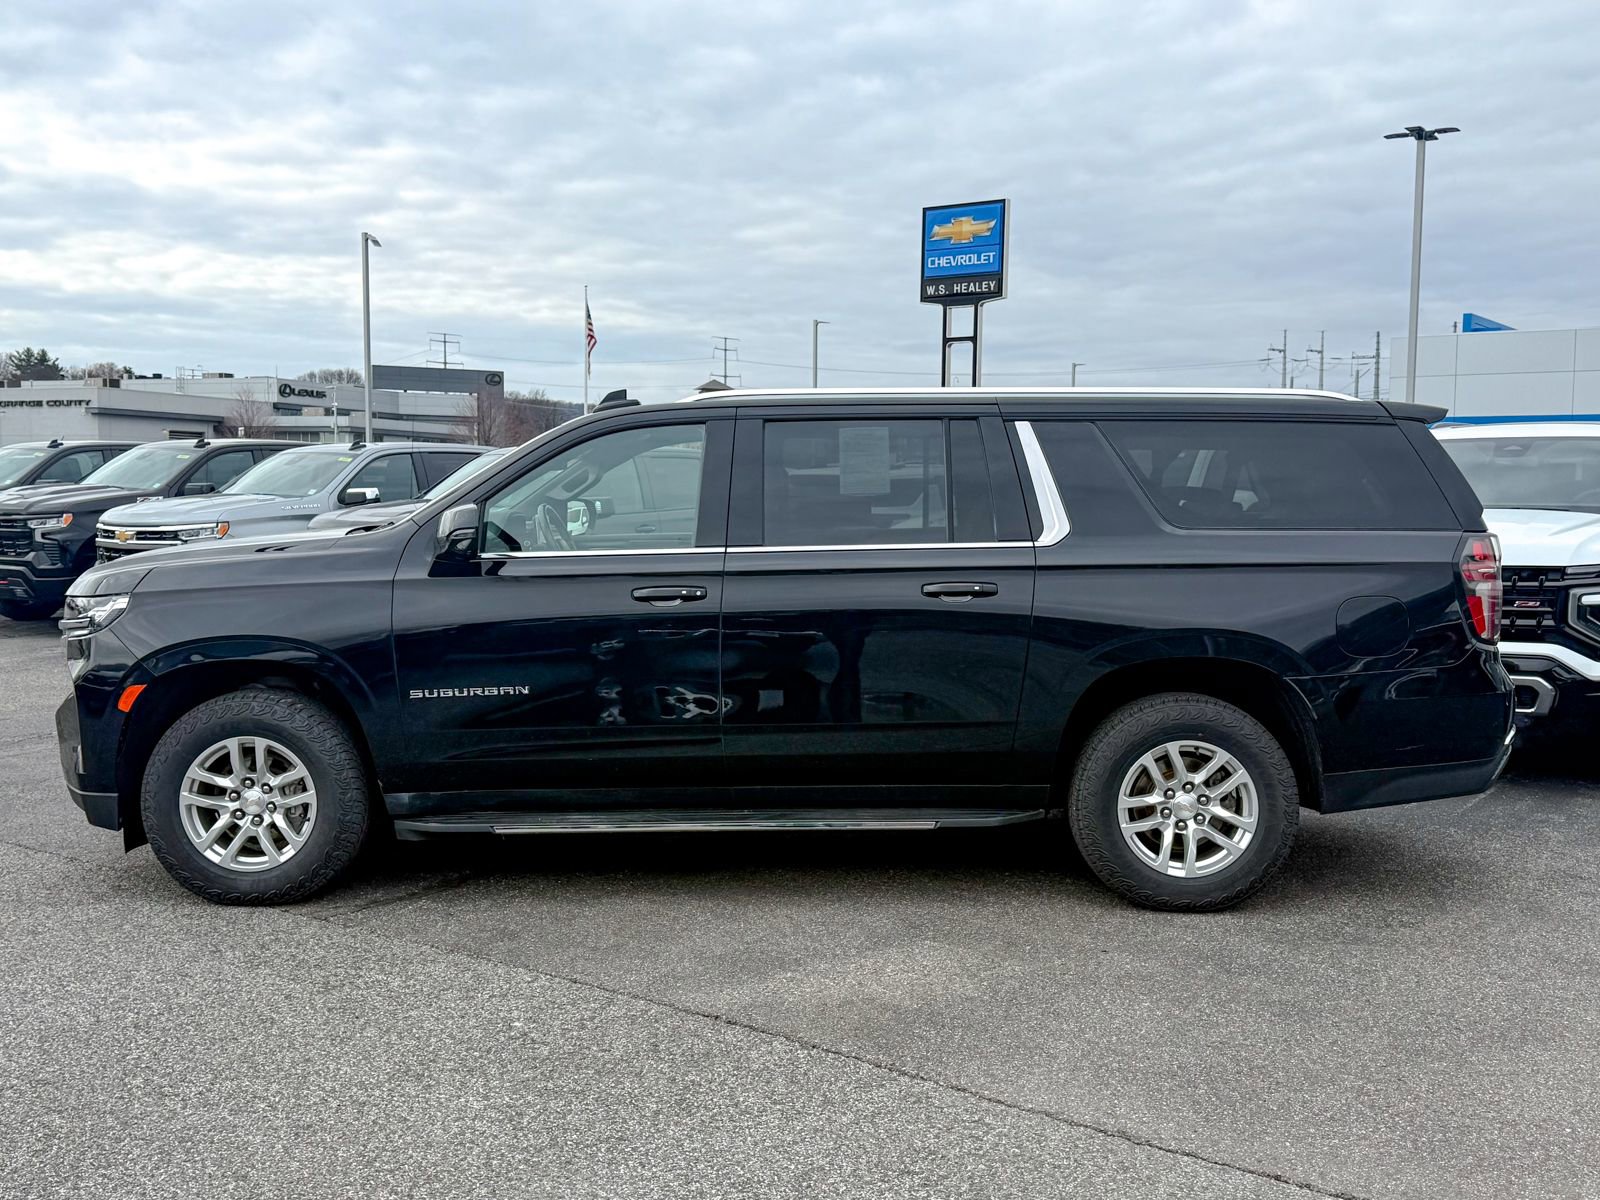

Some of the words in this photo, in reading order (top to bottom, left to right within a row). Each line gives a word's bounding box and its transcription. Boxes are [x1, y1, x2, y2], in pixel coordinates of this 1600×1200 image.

[927, 252, 996, 268] CHEVROLET
[926, 284, 949, 295] W.S.
[953, 281, 996, 293] HEALEY
[291, 387, 327, 399] LEXUS
[409, 686, 530, 699] SUBURBAN
